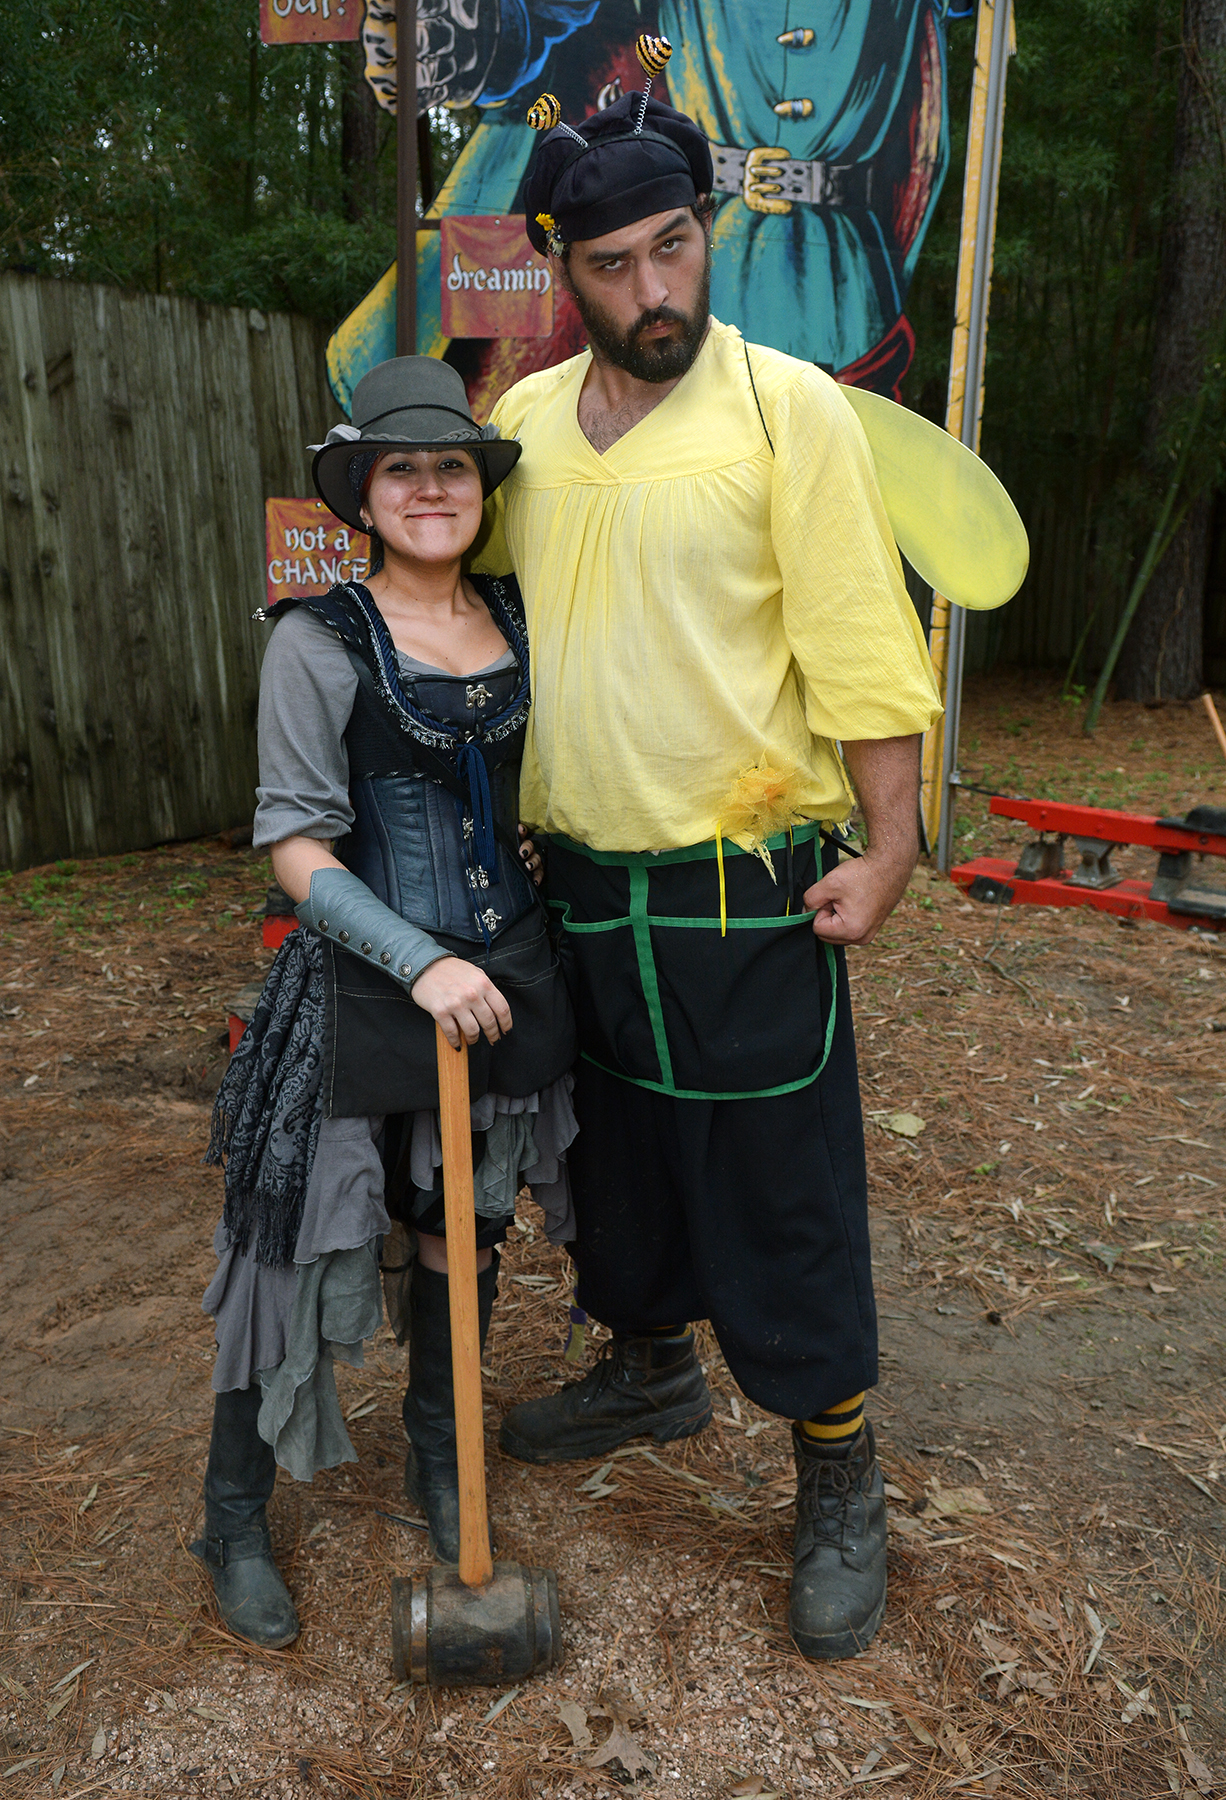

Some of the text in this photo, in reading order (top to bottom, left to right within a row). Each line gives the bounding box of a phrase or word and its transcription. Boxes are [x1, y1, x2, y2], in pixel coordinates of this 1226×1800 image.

[284, 525, 351, 552] not a
[268, 557, 369, 585] CHANCE
